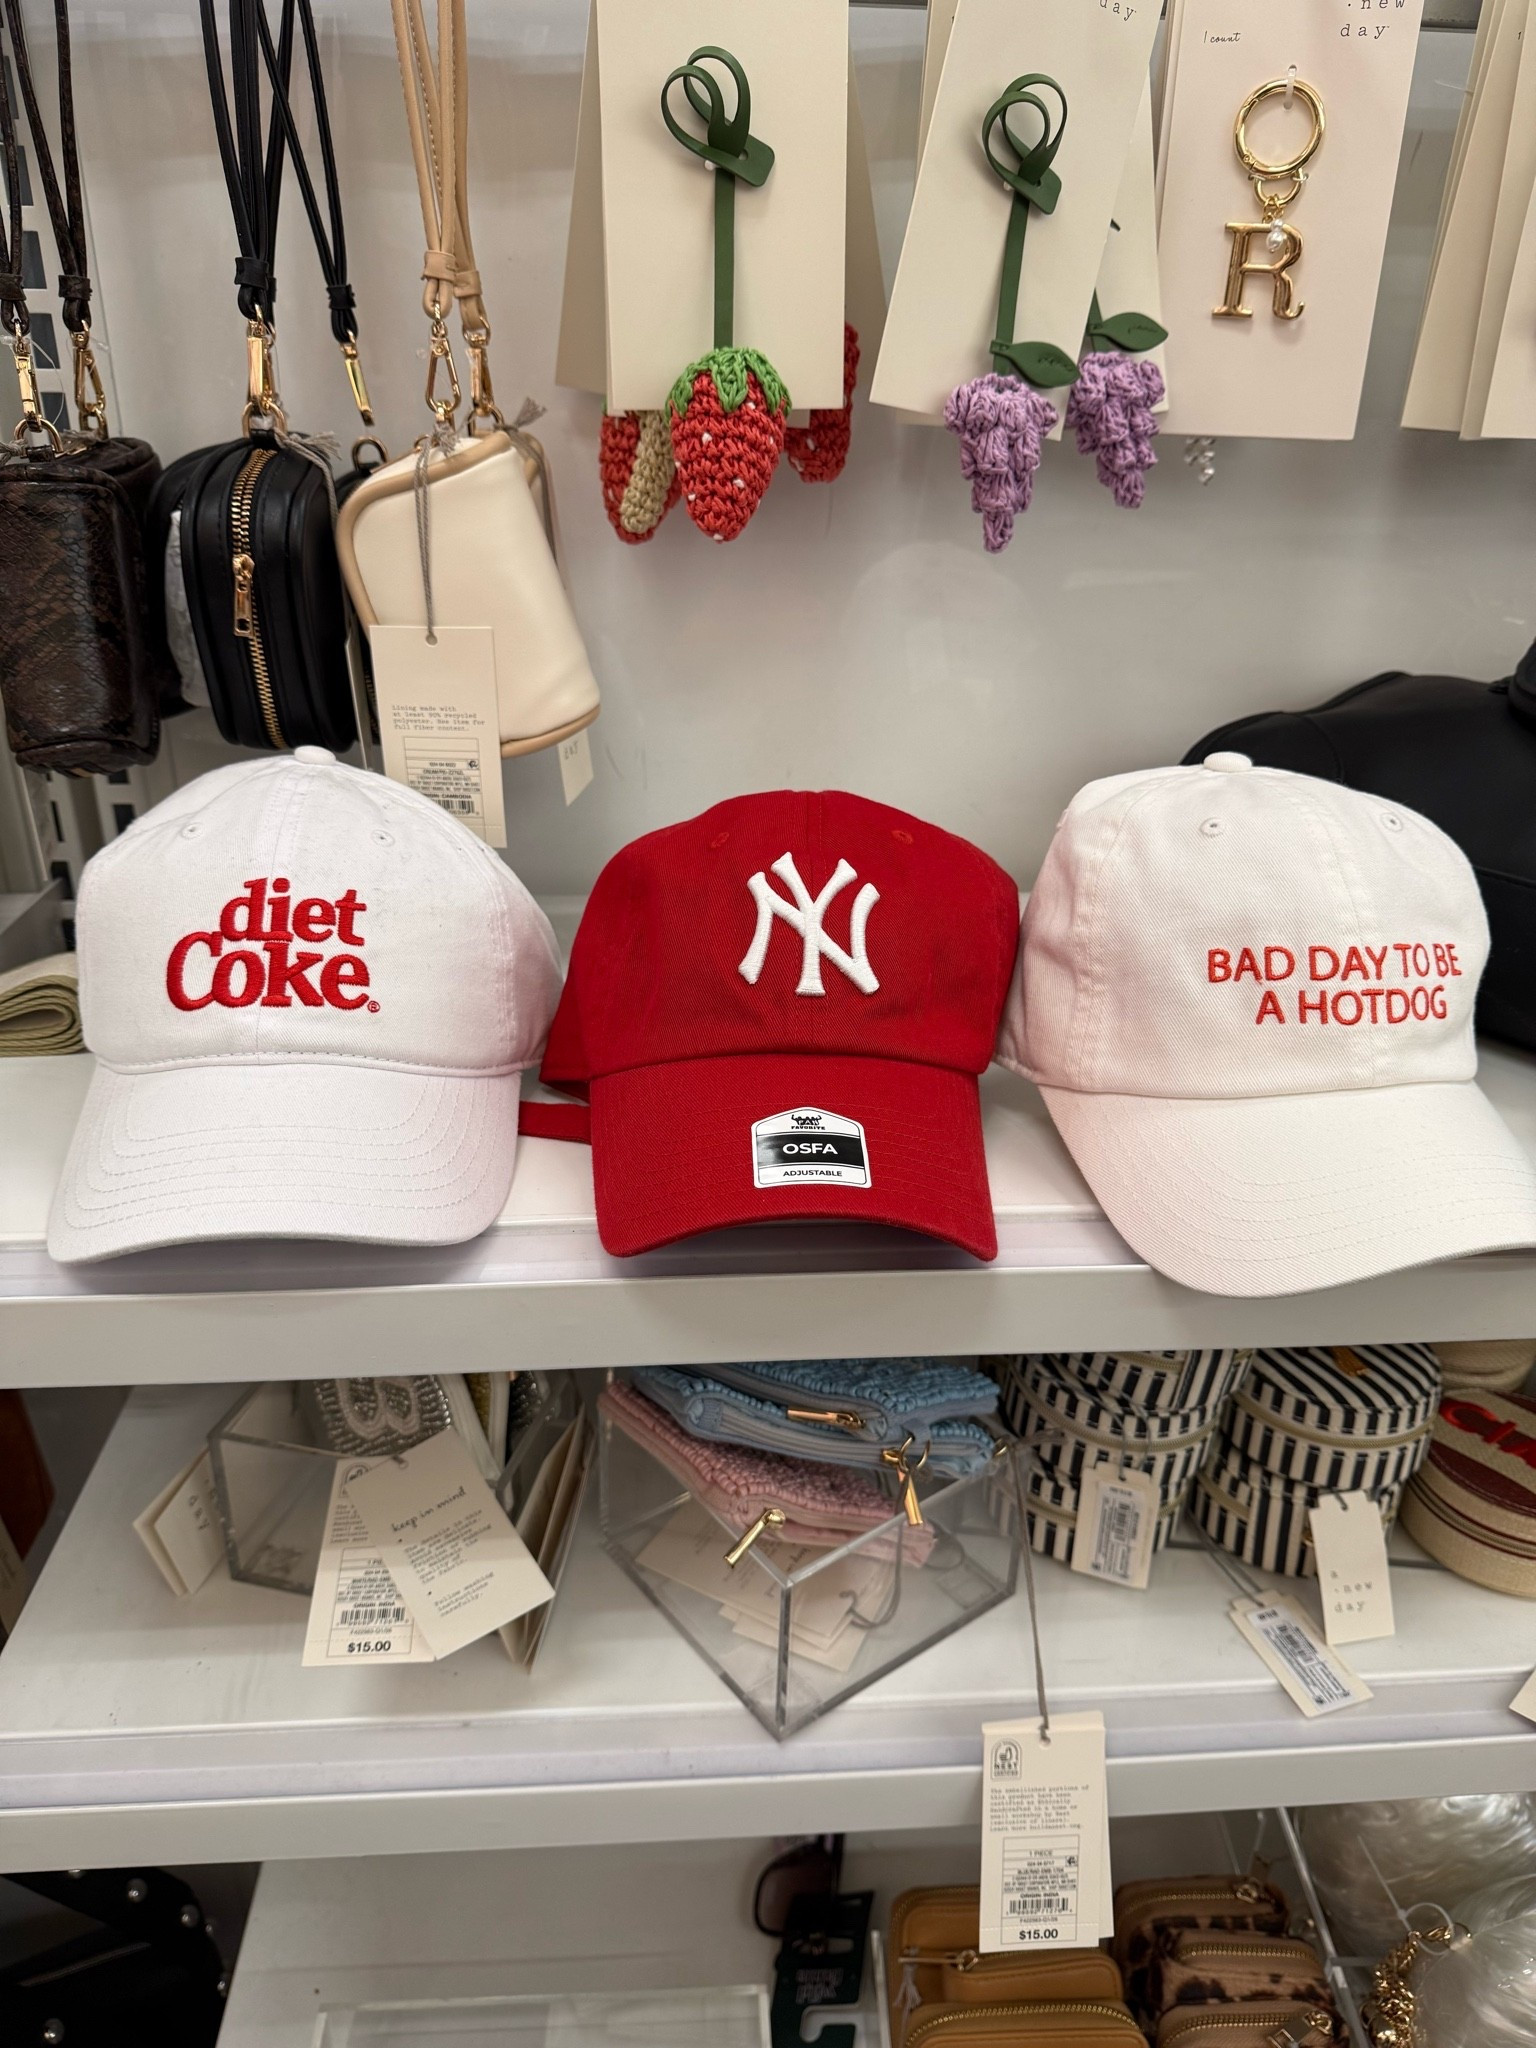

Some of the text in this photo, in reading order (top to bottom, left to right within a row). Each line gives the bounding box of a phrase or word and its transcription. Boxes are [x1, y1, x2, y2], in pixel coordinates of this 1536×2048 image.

[1210, 32, 1242, 43] count
[220, 877, 367, 946] diet
[738, 851, 880, 996] NY
[1207, 942, 1462, 983] BAD DAY TO BE
[1255, 985, 1448, 1026] A HOTDOG
[782, 1143, 838, 1155] OSFA
[391, 1485, 466, 1532] keep in mind
[1334, 1601, 1365, 1613] day
[347, 1640, 391, 1653] $15.00
[1019, 1928, 1059, 1940] $15.00
